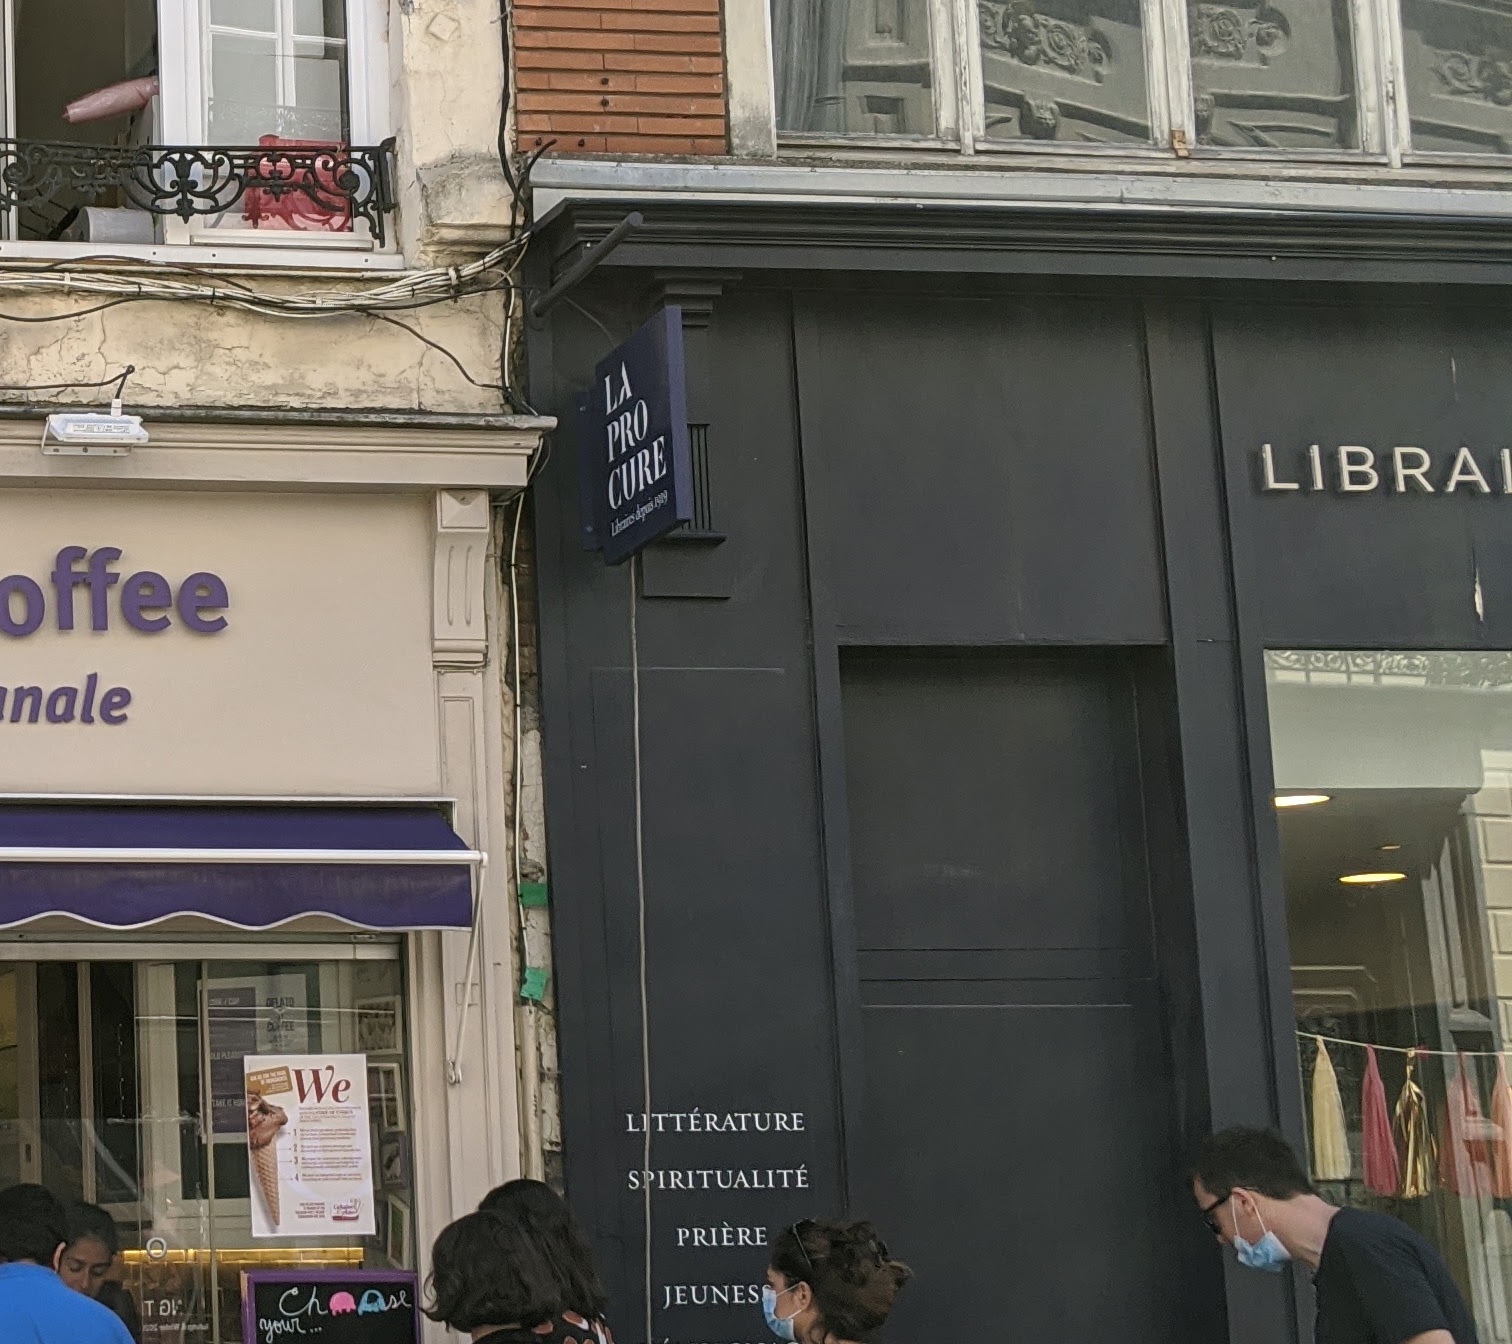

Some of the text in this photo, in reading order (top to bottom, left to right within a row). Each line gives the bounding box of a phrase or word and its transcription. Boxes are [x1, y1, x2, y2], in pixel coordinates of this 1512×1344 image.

[603, 360, 633, 416] LA
[606, 399, 648, 463] PRO
[608, 436, 667, 510] CURE
[291, 1064, 352, 1103] We
[625, 1106, 806, 1133] LITTÉRATURE
[627, 1163, 810, 1191] SPIRITUALITÉ
[676, 1220, 769, 1247] PRIÈRE
[662, 1284, 772, 1310] JEUNES
